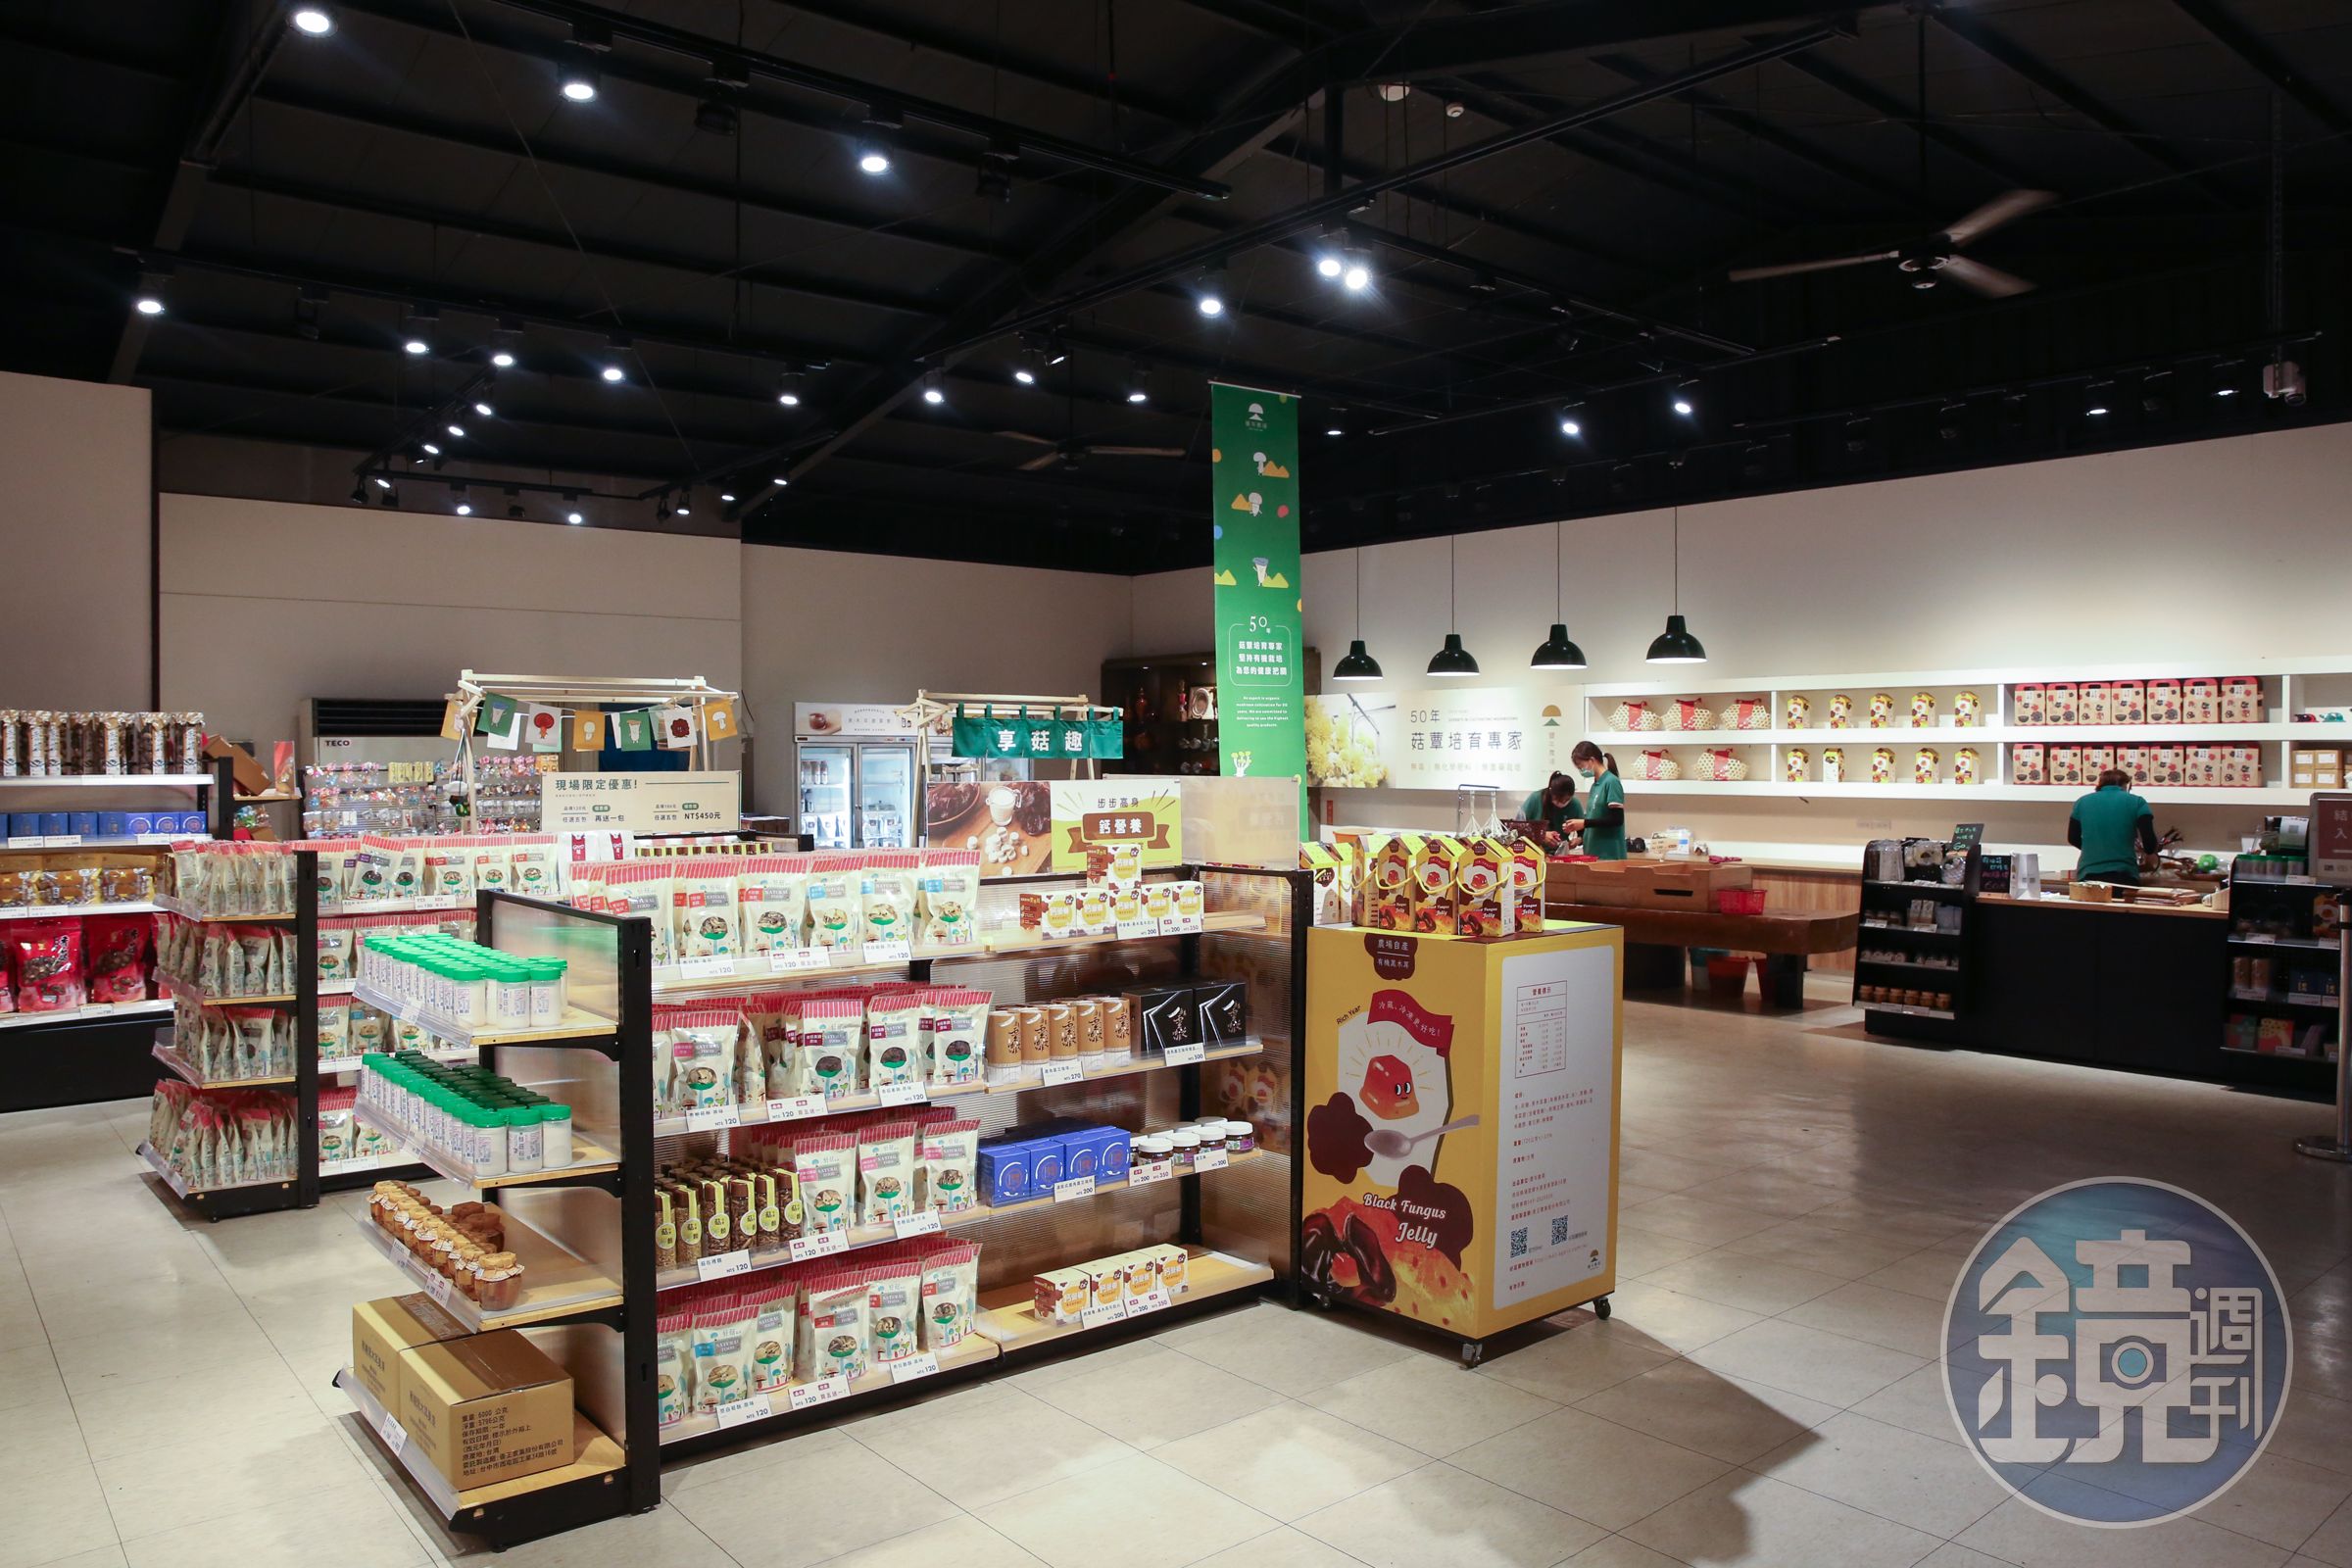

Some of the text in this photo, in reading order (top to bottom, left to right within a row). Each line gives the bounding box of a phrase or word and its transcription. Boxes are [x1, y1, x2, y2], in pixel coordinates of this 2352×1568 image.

[1410, 710, 1441, 723] 50年
[997, 730, 1083, 753] 享菇趣
[1411, 731, 1522, 751] 菇蕈培育專家
[556, 779, 638, 791] 現場限定優惠!
[1098, 797, 1139, 808] 步步高身
[1099, 818, 1142, 834] 鈣營養
[1378, 939, 1408, 951] 農場自產
[1336, 1005, 1361, 1024] Rich Year
[1363, 1193, 1446, 1220] Black Fungus
[1396, 1222, 1438, 1250] Jelly
[805, 1396, 816, 1404] 120
[495, 1406, 508, 1415] 公克
[756, 1408, 768, 1417] 120
